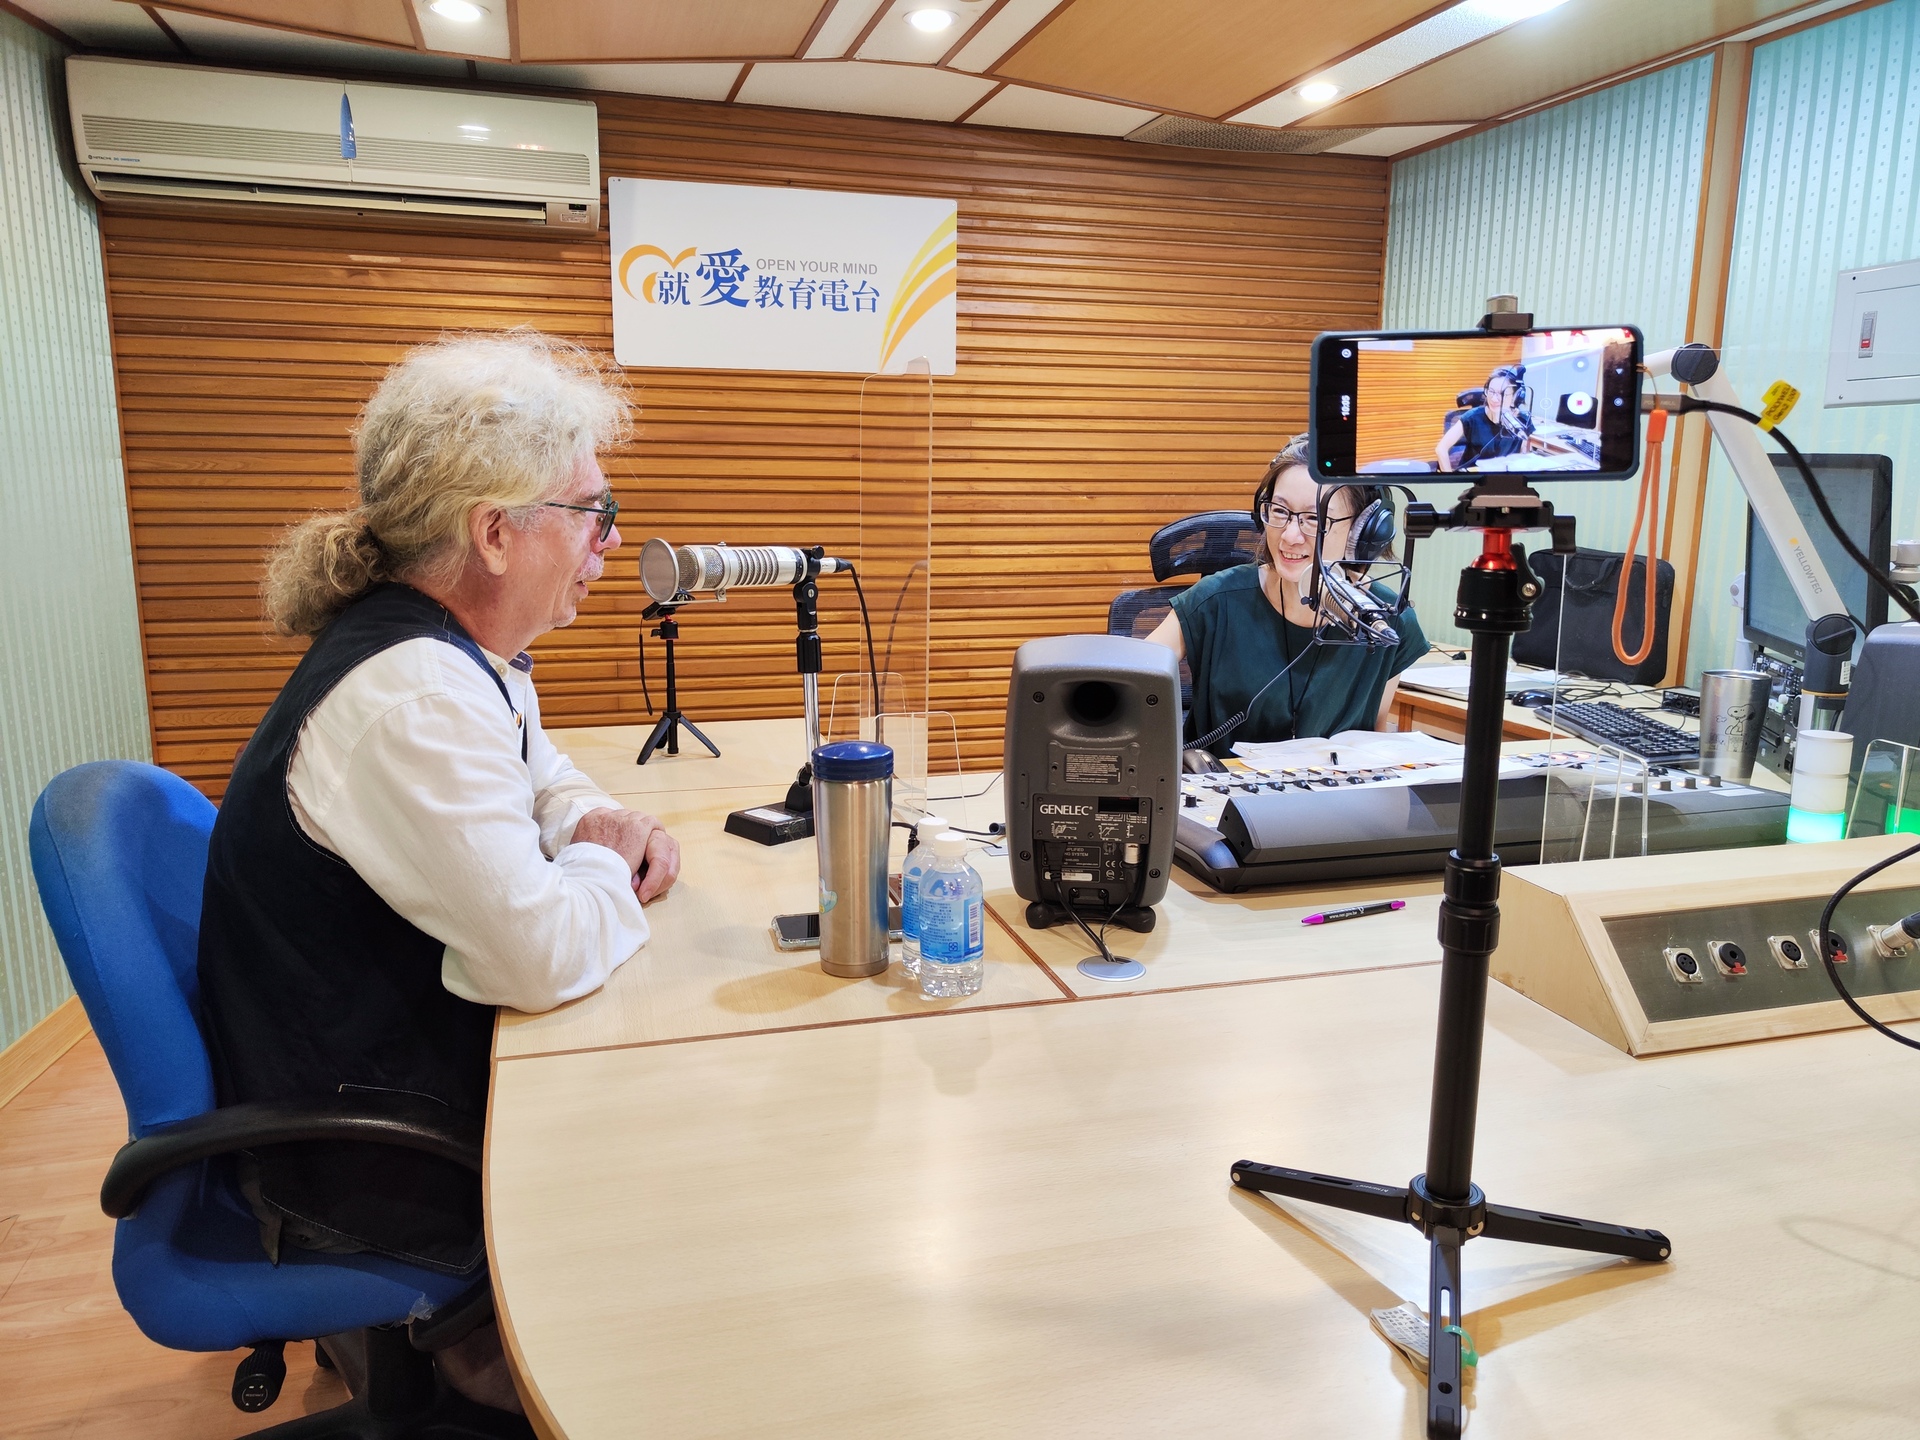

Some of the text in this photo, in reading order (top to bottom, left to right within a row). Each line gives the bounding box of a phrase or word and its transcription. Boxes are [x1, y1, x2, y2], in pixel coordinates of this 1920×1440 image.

[756, 258, 878, 275] OPEN YOUR MIND
[1341, 394, 1350, 417] 10:05
[1793, 546, 1823, 595] YELLOWTEC
[1040, 804, 1090, 816] GENELEC
